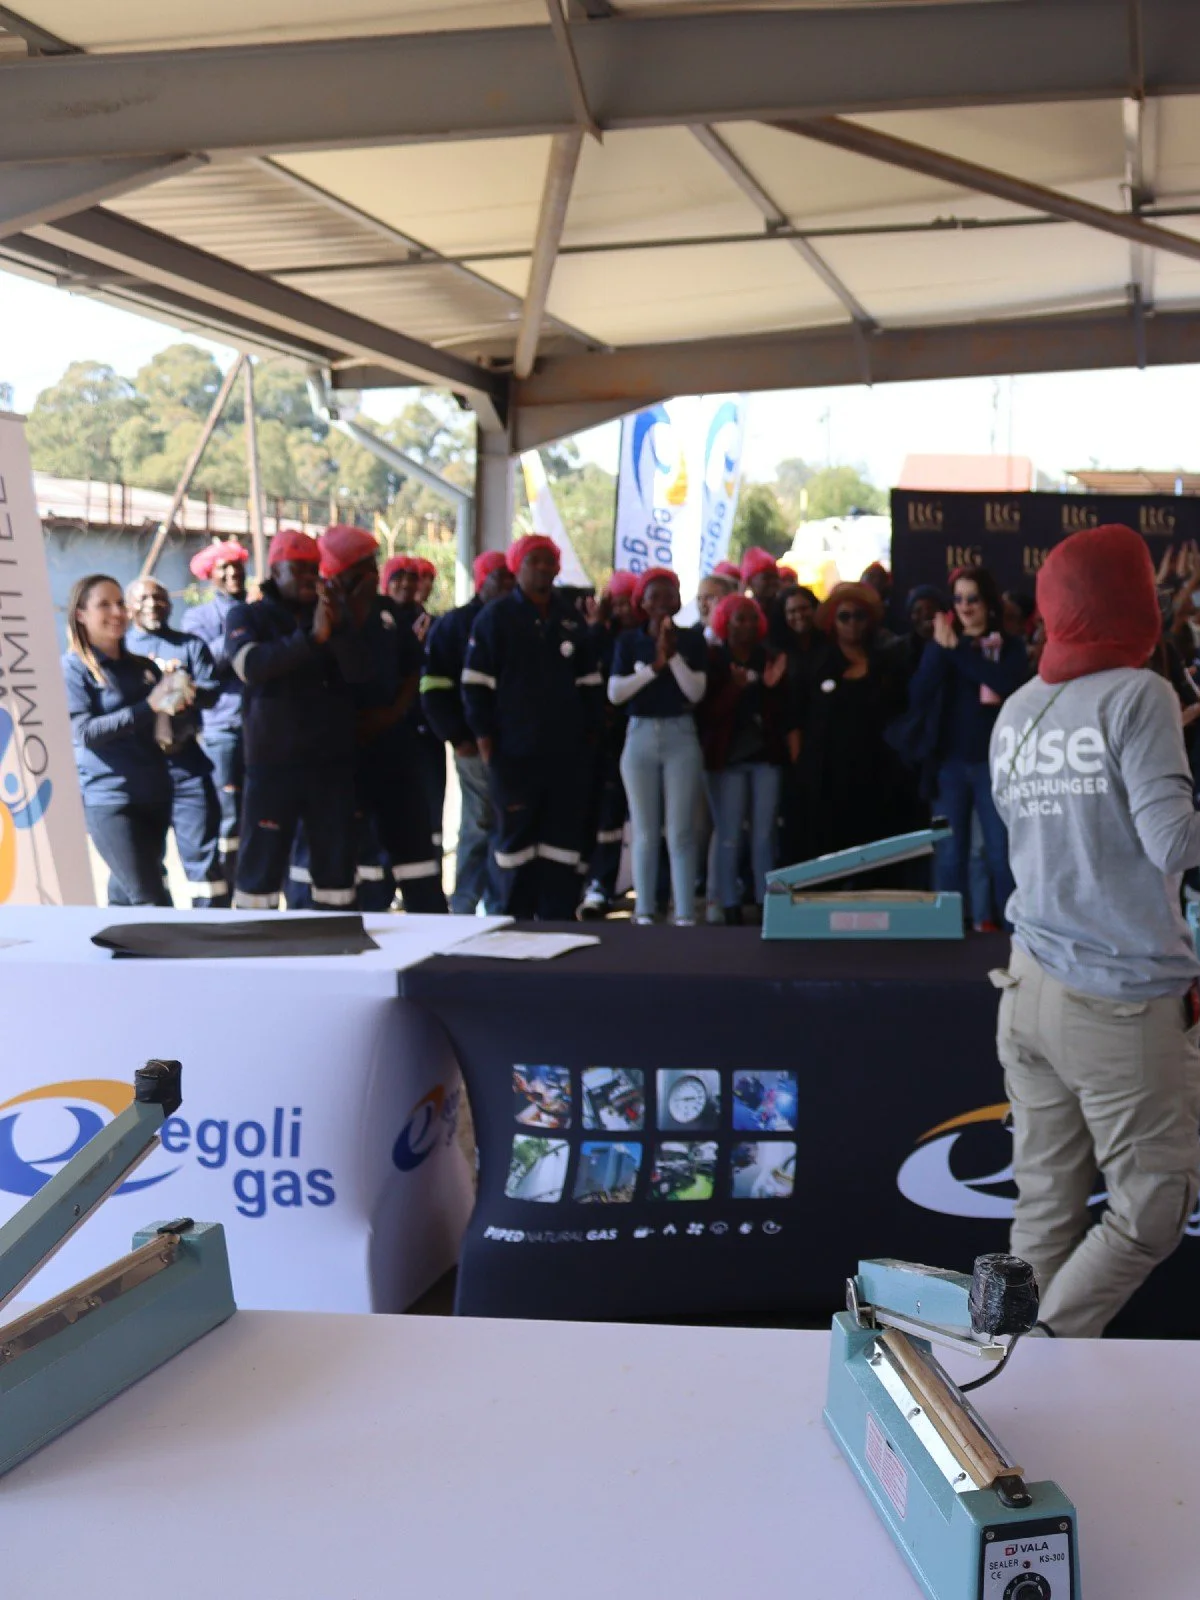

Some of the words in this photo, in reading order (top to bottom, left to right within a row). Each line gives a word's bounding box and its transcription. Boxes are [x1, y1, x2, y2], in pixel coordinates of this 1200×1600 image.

[622, 536, 649, 575] ga
[646, 507, 673, 565] ego
[160, 1107, 302, 1169] egoli
[233, 1168, 336, 1218] gas
[989, 1559, 1019, 1570] SEALER
[1020, 1542, 1049, 1553] VALA
[1040, 1552, 1065, 1563] KS-300
